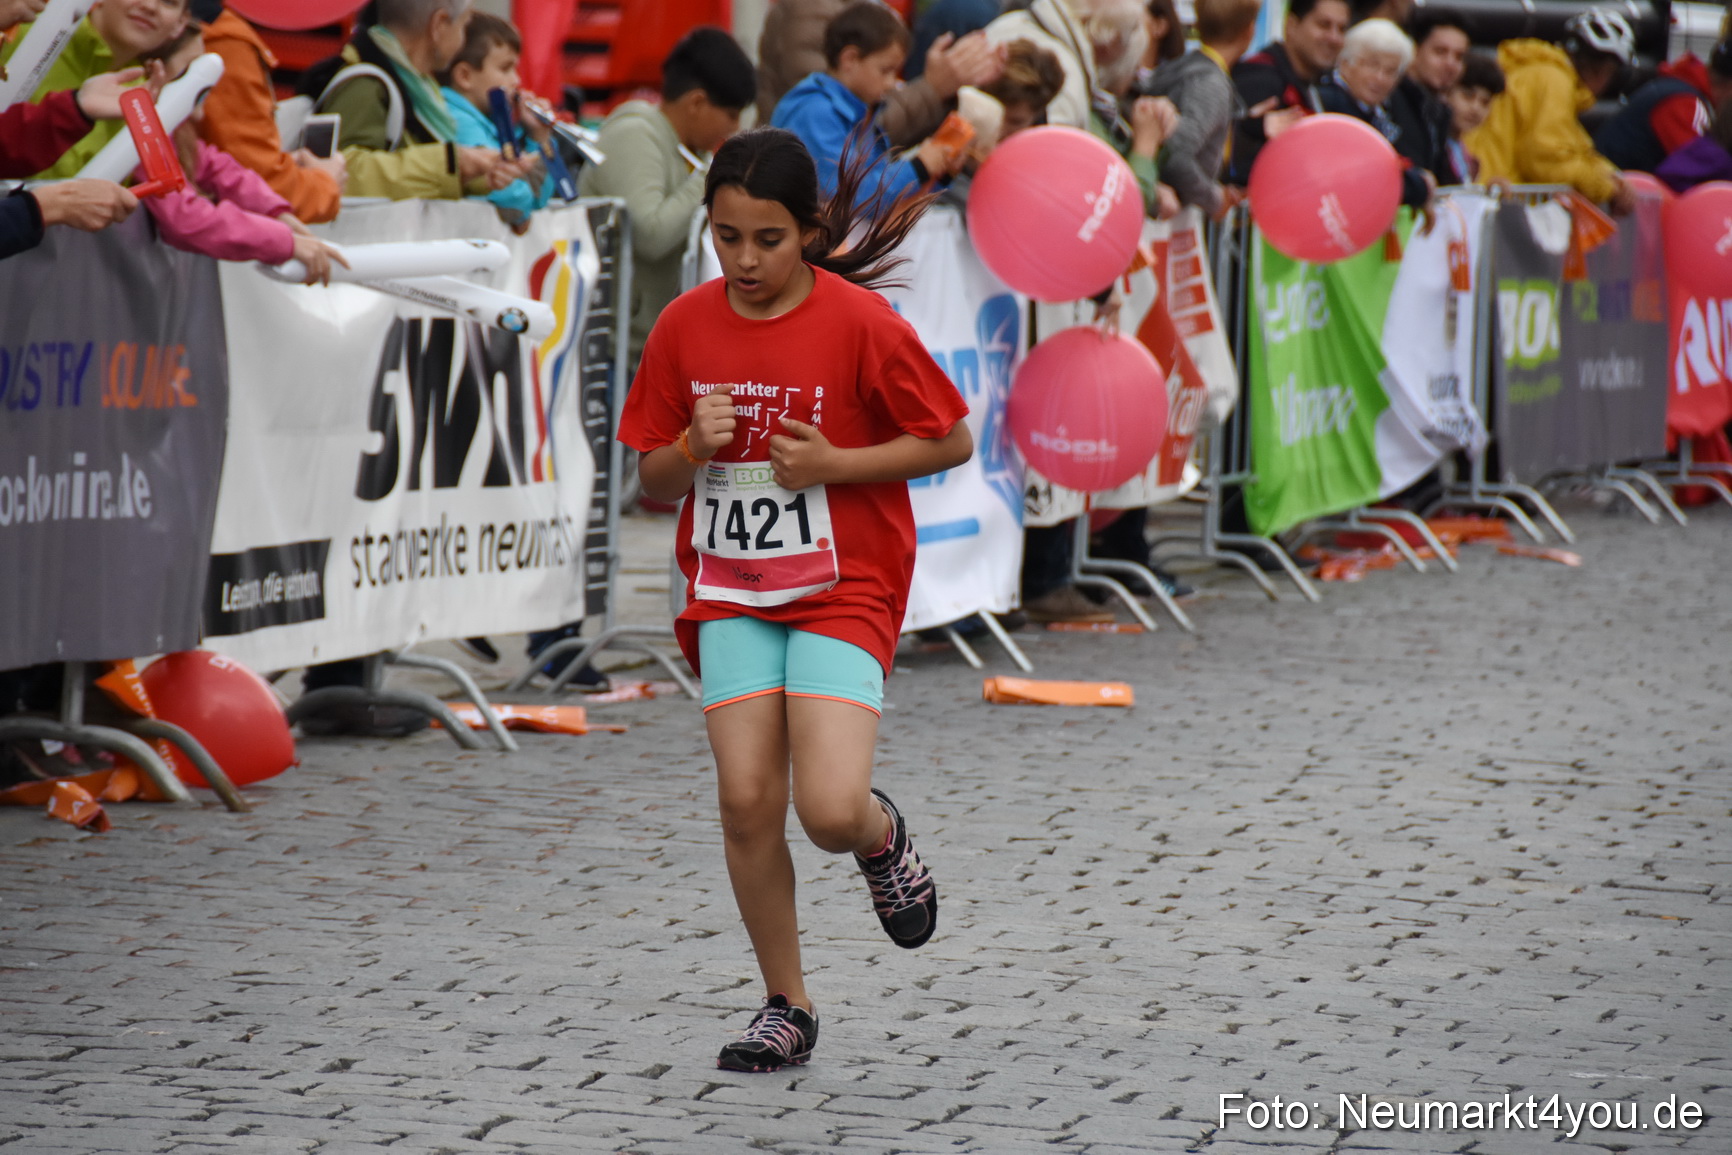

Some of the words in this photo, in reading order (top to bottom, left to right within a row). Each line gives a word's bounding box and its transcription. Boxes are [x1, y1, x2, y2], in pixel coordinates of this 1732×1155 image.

[691, 380, 780, 398] Neuarkter
[734, 402, 762, 421] auf
[706, 493, 812, 551] 7421
